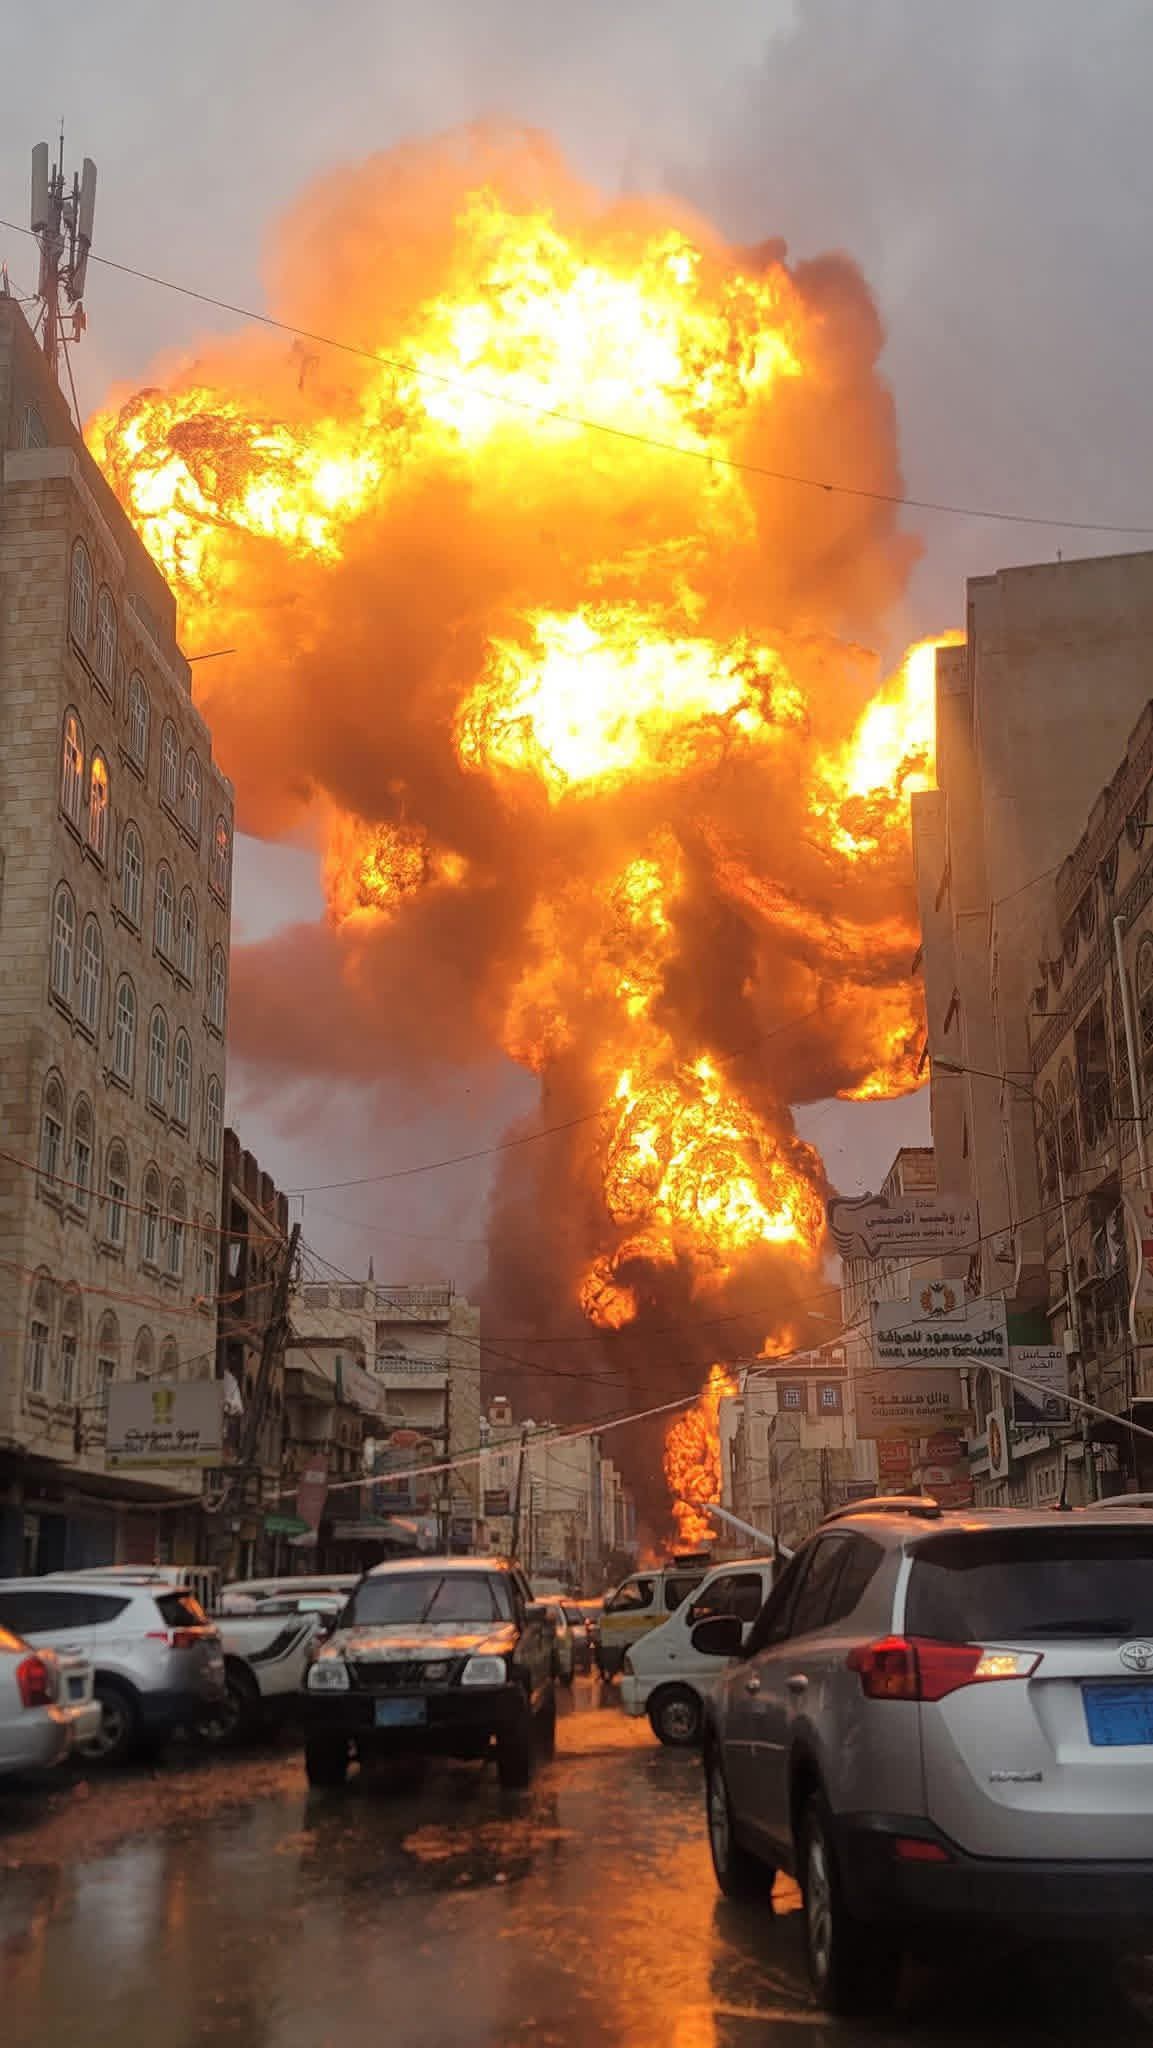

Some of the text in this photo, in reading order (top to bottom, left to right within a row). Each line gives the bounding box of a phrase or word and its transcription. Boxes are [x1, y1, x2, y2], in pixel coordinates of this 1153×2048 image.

[878, 1329, 1004, 1345] وائل مسعود للصرافة
[878, 1345, 1004, 1358] WAEL MASOUD EXCHANGE
